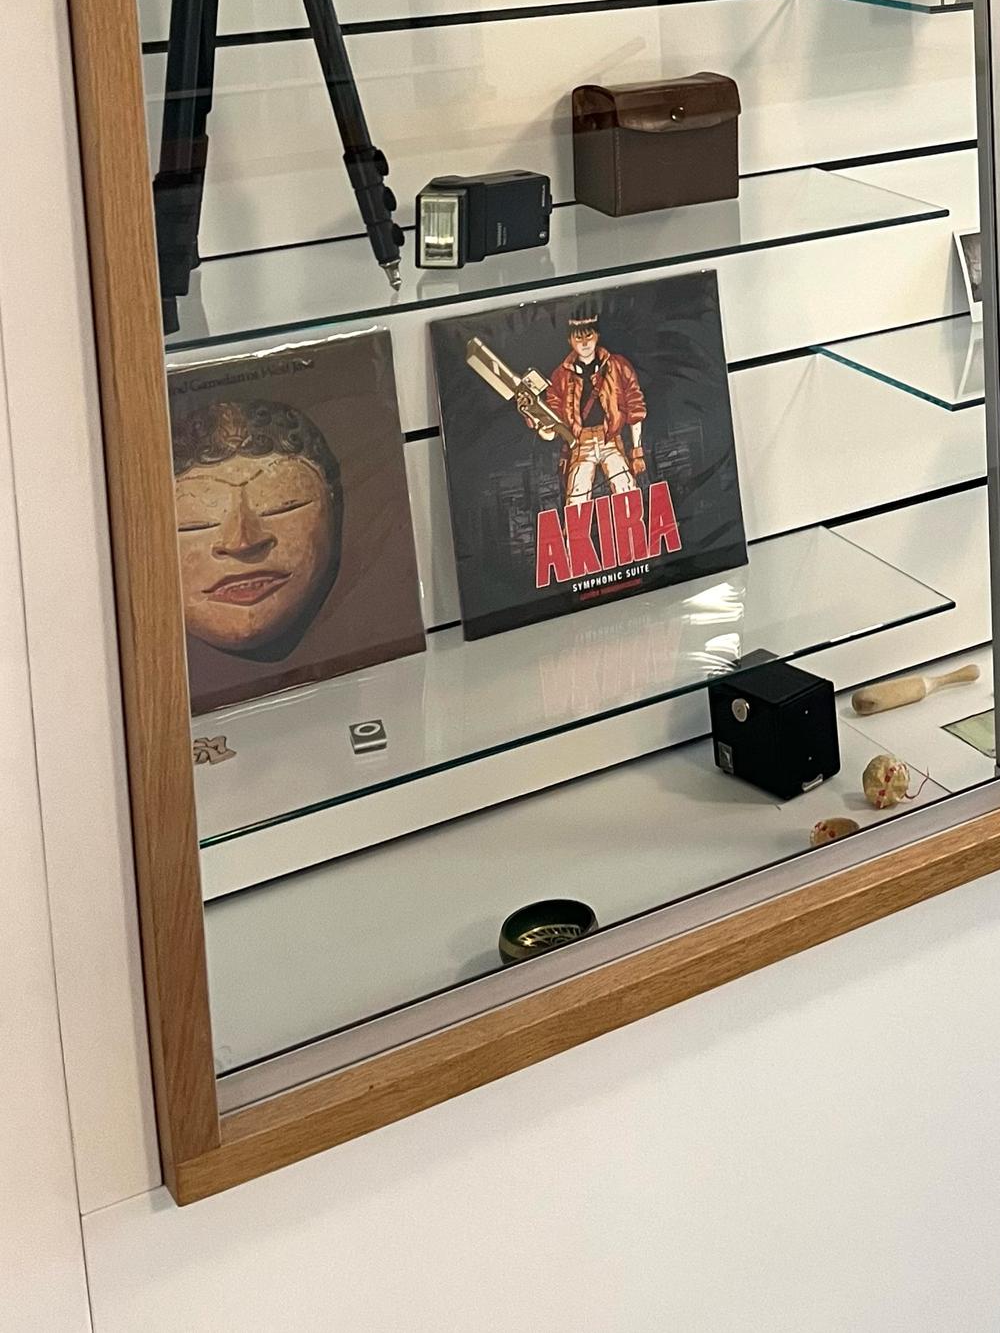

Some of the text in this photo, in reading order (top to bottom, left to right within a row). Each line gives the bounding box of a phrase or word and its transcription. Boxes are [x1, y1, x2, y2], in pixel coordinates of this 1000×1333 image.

[536, 481, 683, 589] AKIRA
[572, 570, 624, 593] SYMPHONIC
[626, 563, 650, 578] SUITE
